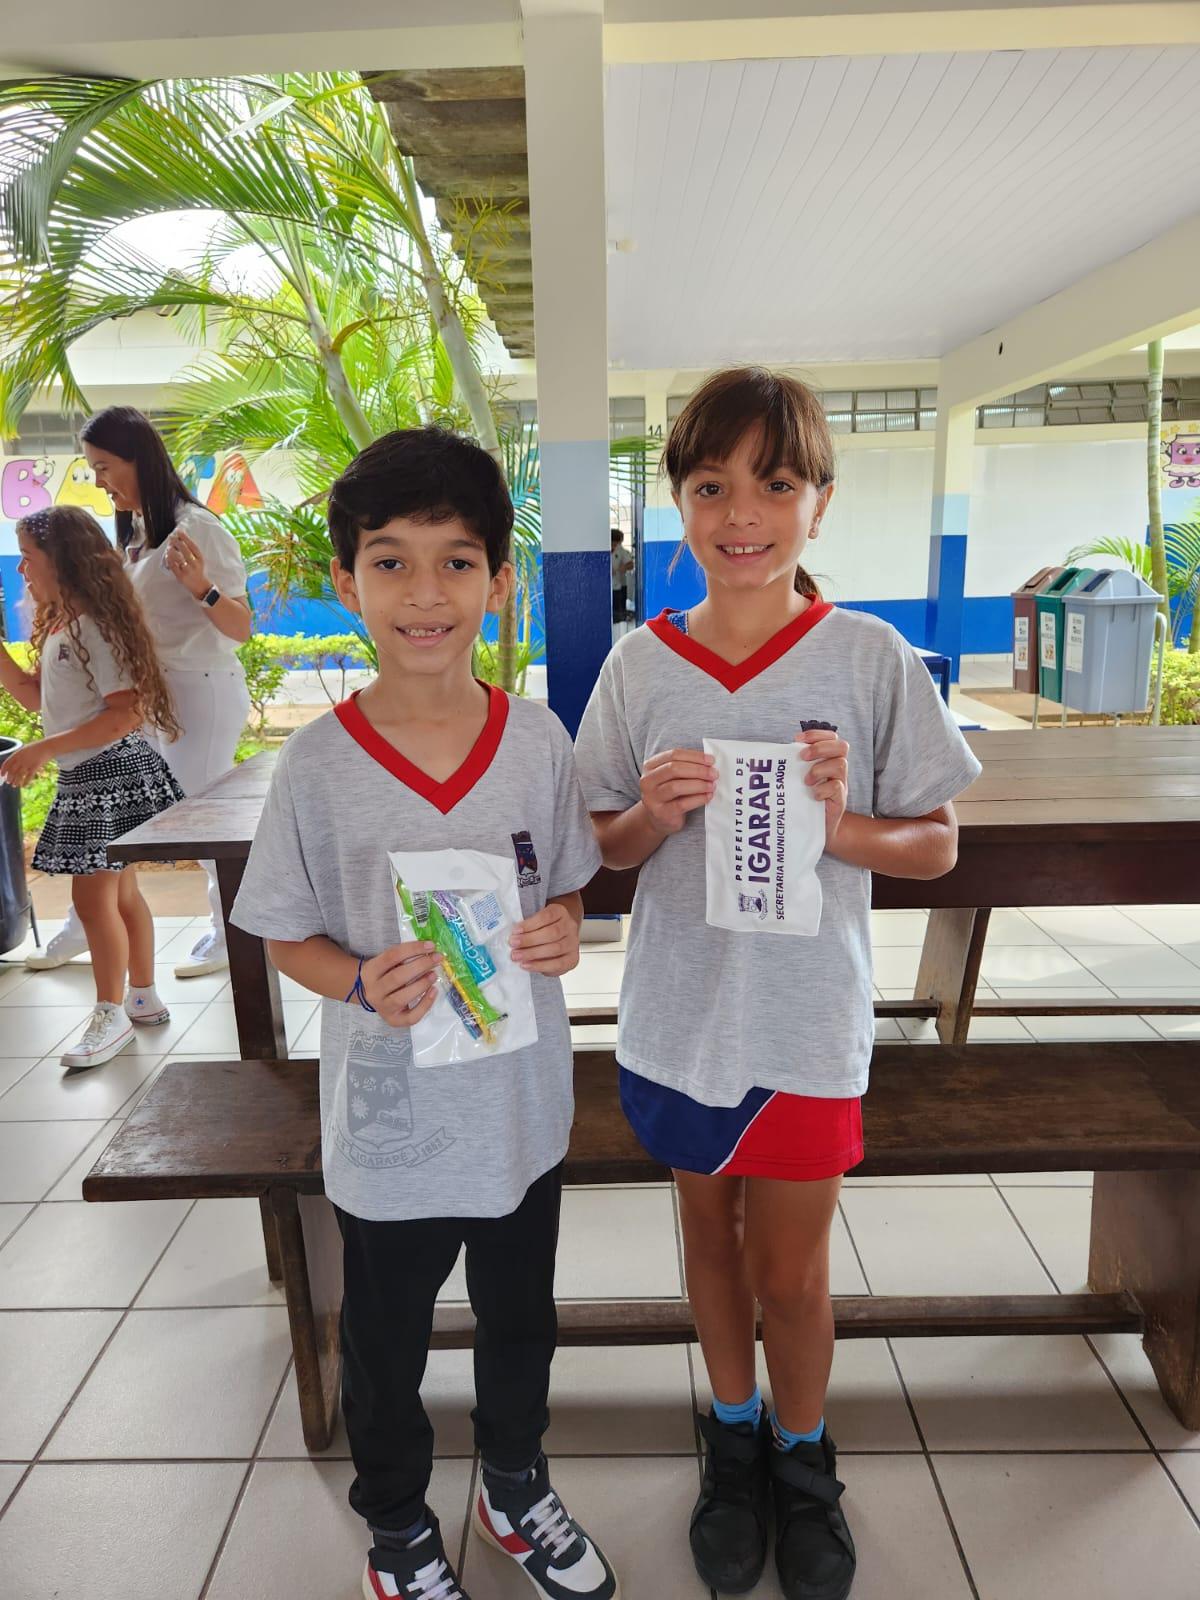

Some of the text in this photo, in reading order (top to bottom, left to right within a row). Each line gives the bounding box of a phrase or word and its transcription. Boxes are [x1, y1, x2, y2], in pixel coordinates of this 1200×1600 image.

[648, 424, 662, 440] 14
[735, 757, 744, 881] PREFEITURA DE
[746, 758, 773, 884] IGARAPÉ
[776, 758, 787, 921] SECRETARIA MUNICIPAL DE SAÚDE
